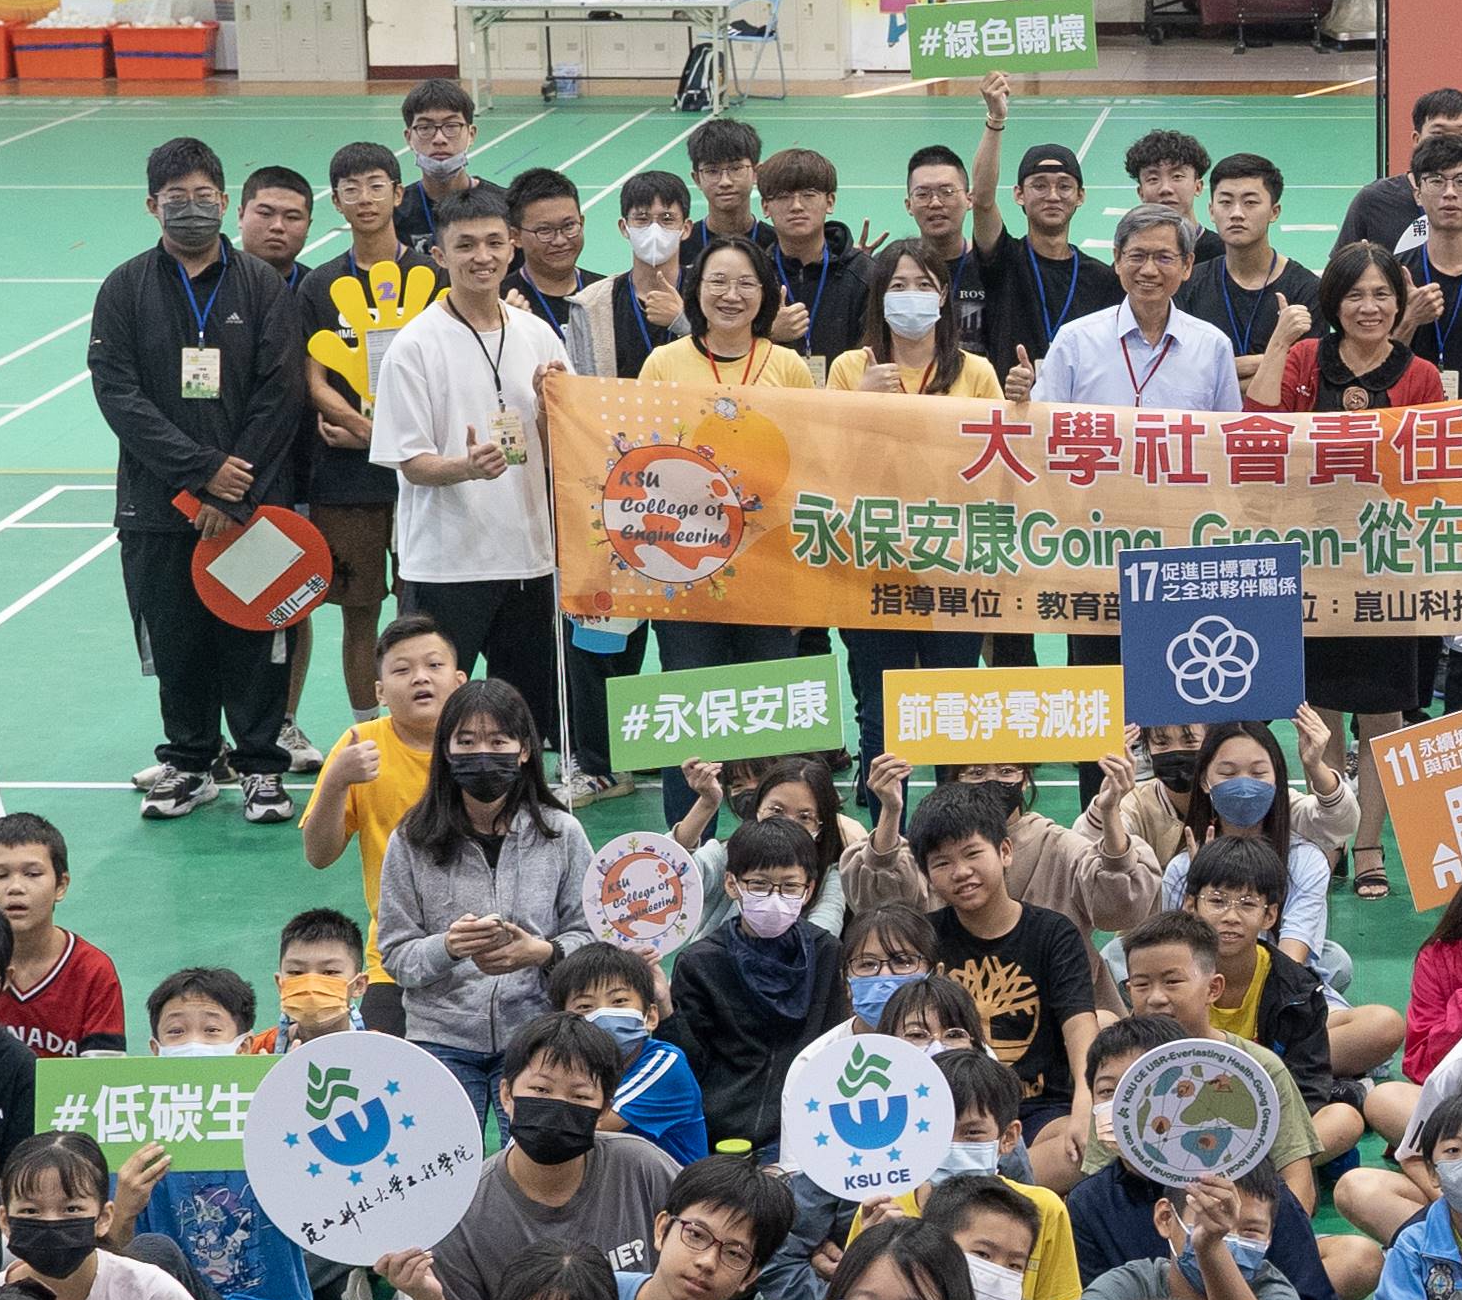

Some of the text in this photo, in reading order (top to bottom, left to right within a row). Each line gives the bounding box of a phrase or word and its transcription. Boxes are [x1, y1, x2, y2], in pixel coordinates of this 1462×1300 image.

[918, 13, 1088, 59] #綠色關懷
[377, 282, 397, 301] 2
[618, 470, 661, 489] KSU
[620, 497, 727, 521] College of
[619, 524, 732, 550] Engineering
[1124, 561, 1159, 602] 17
[1160, 557, 1278, 582] 促進目標實現
[1161, 576, 1298, 602] 之全球夥伴關係
[621, 679, 829, 745] #永保安康
[897, 688, 1111, 743] 節電淨零減排
[1384, 741, 1420, 787] 11
[607, 878, 631, 895] KSU
[613, 879, 671, 909] College of
[618, 895, 680, 924] Engineering
[1123, 1081, 1141, 1104] KSU
[1135, 1069, 1149, 1083] CE
[1147, 1048, 1227, 1073] USR-Everlasting
[1226, 1054, 1268, 1106] Health-Going
[844, 1168, 912, 1191] KSU CE
